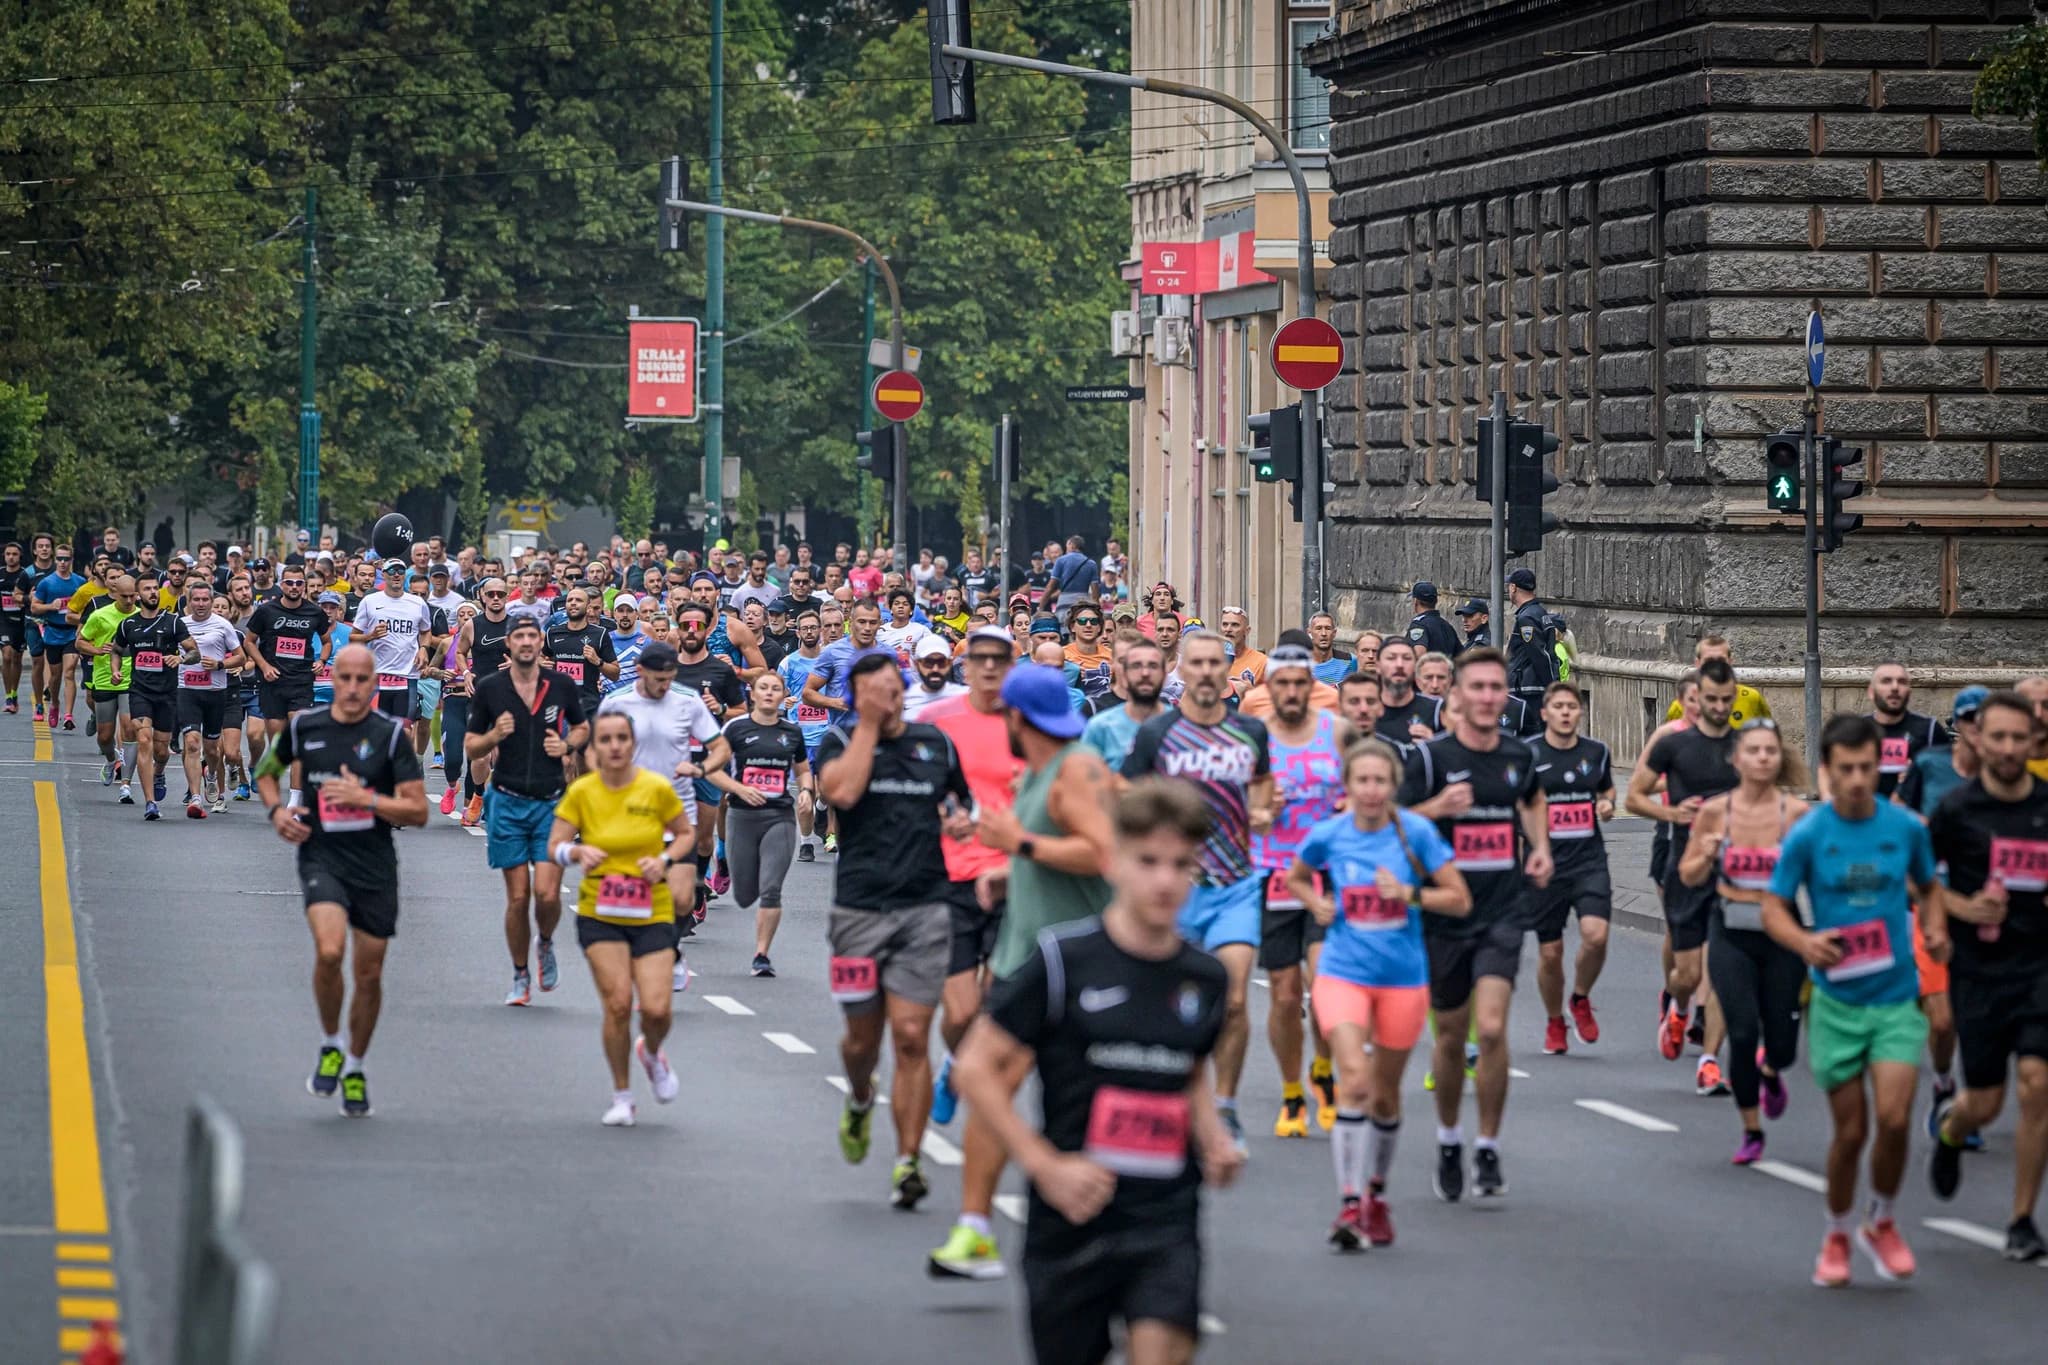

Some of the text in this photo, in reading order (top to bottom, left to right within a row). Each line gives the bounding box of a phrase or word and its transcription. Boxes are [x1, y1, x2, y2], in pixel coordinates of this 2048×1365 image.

[638, 348, 686, 361] KRALJ
[638, 361, 686, 372] USKORO
[637, 372, 686, 384] DOLAZI!
[280, 641, 303, 651] 2559
[137, 654, 161, 664] 2628
[186, 673, 209, 682] 2756
[801, 707, 826, 717] 2258
[747, 773, 781, 786] 2683
[1553, 809, 1590, 825] 2415
